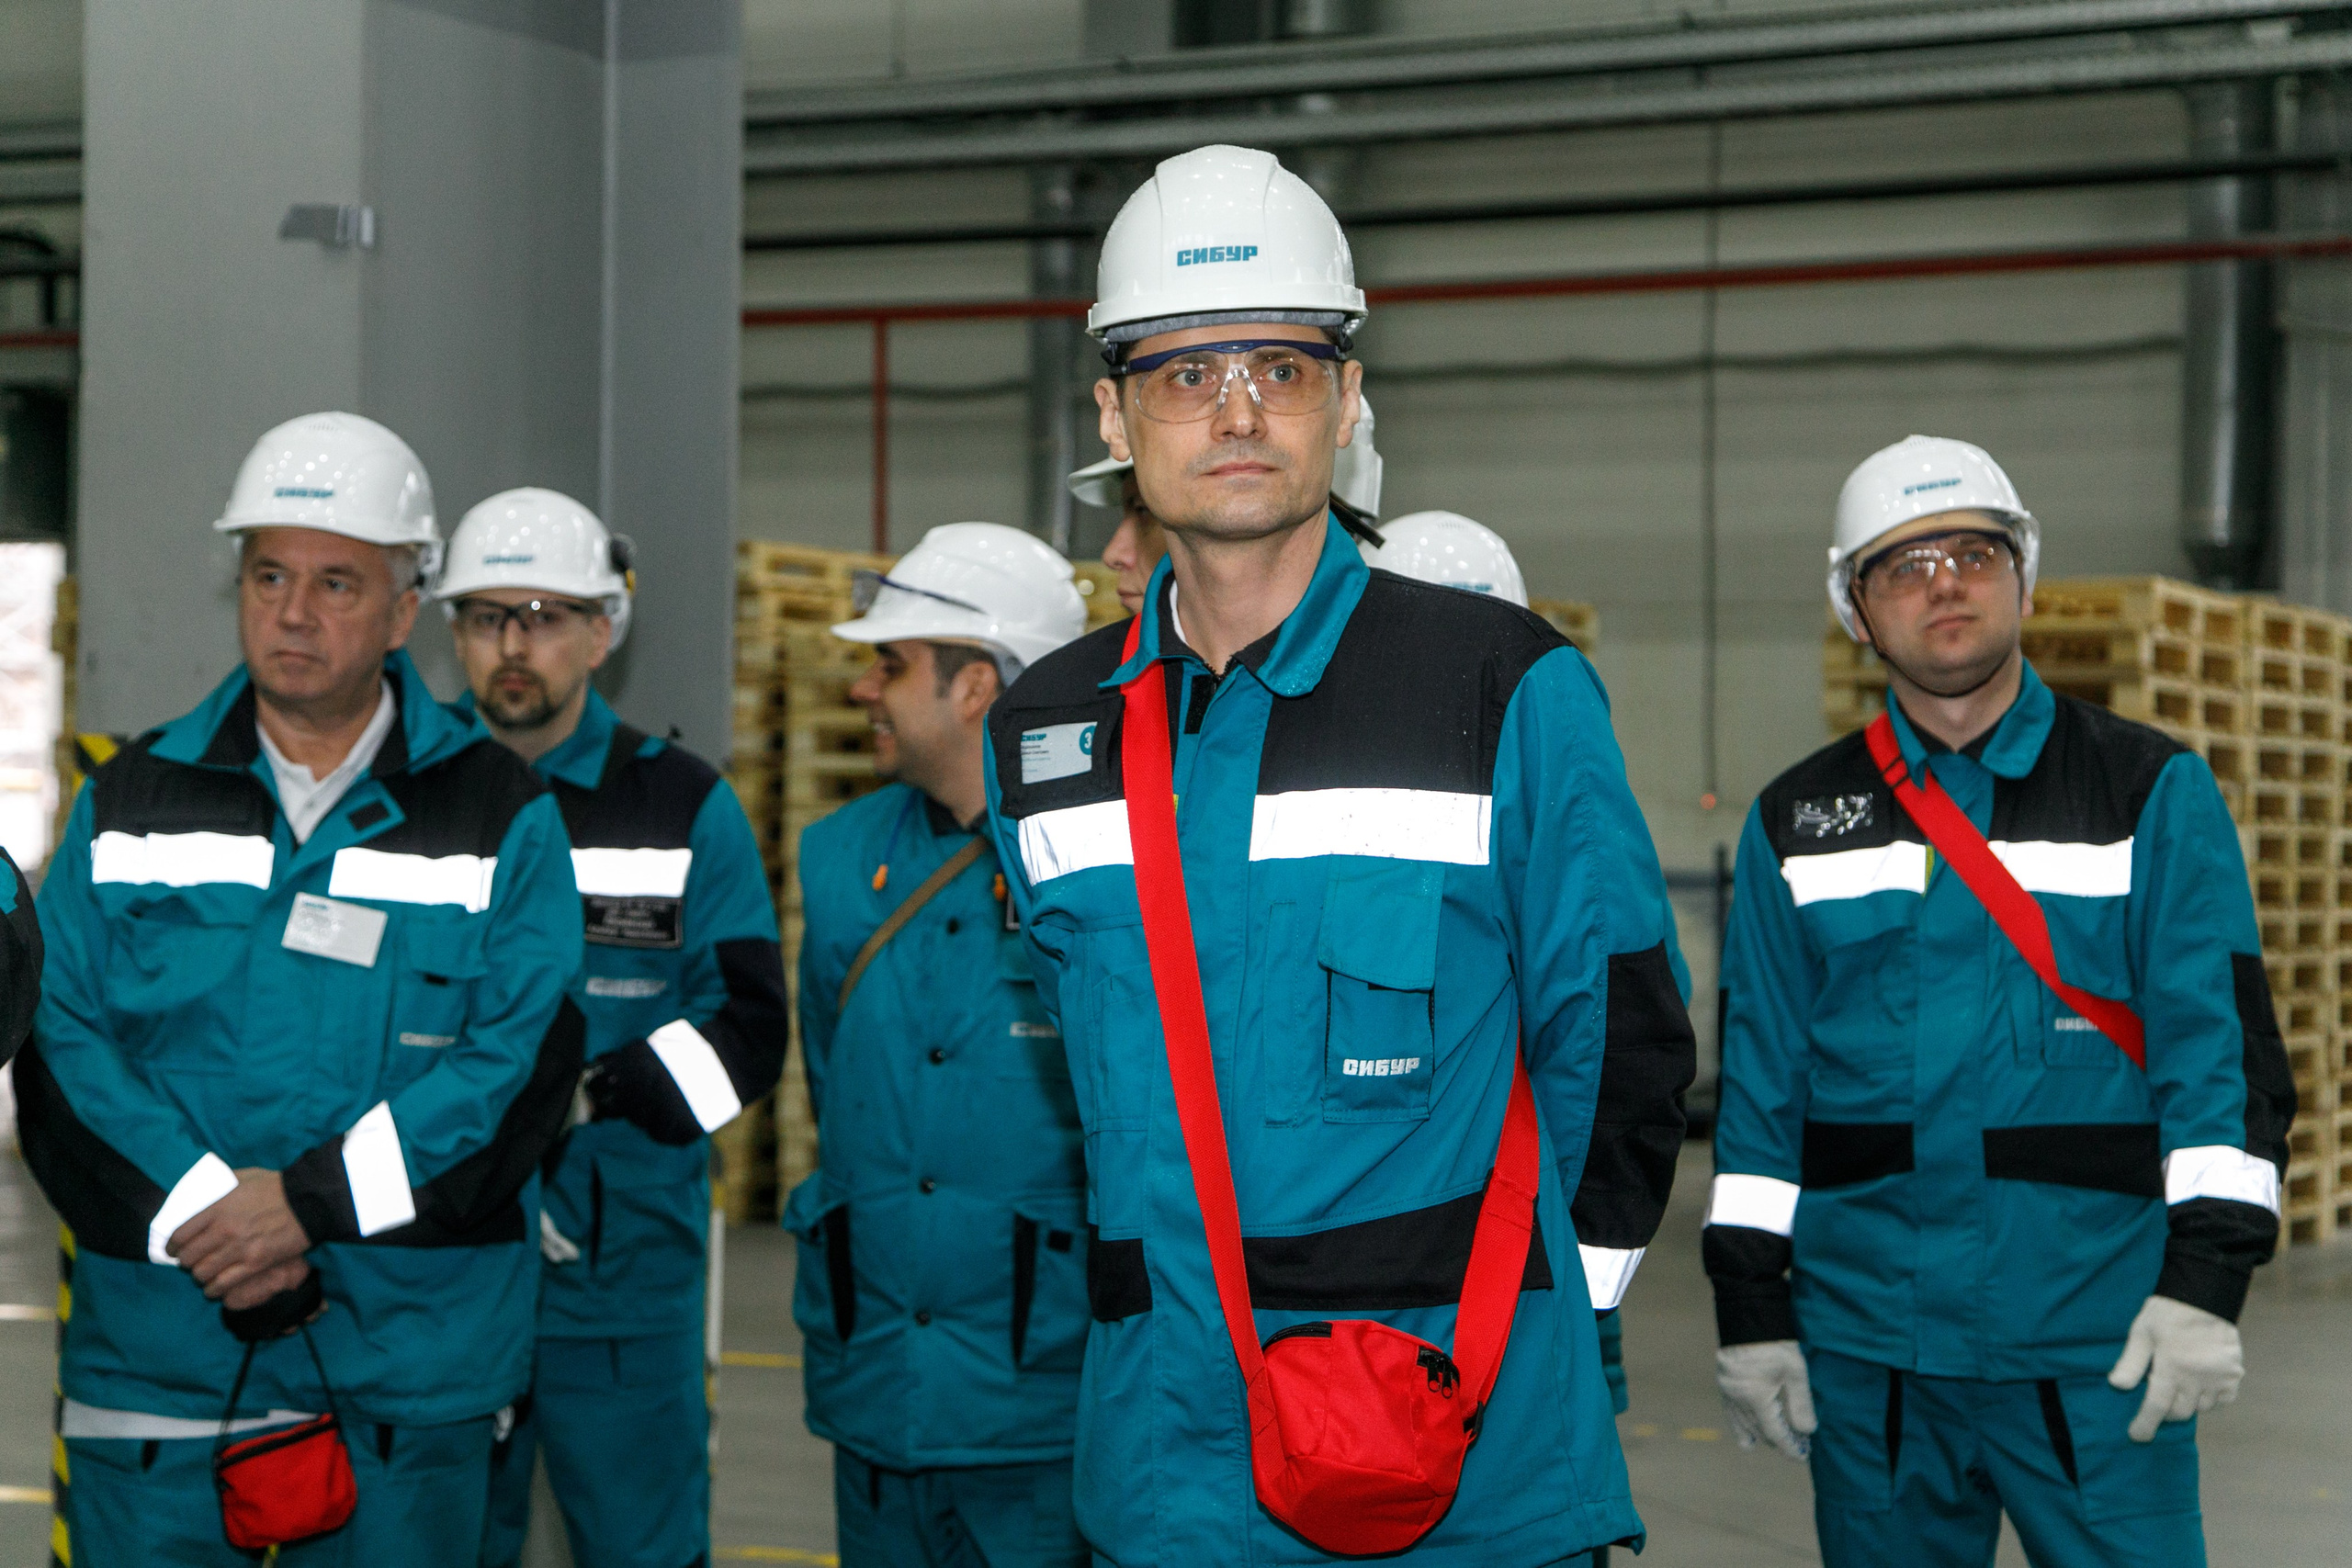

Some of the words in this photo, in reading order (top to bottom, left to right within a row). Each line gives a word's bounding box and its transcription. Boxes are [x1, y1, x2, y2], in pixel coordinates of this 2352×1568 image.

[1177, 245, 1258, 266] СИБУР
[1084, 731, 1092, 749] 3
[1342, 1057, 1420, 1077] СИБУР
